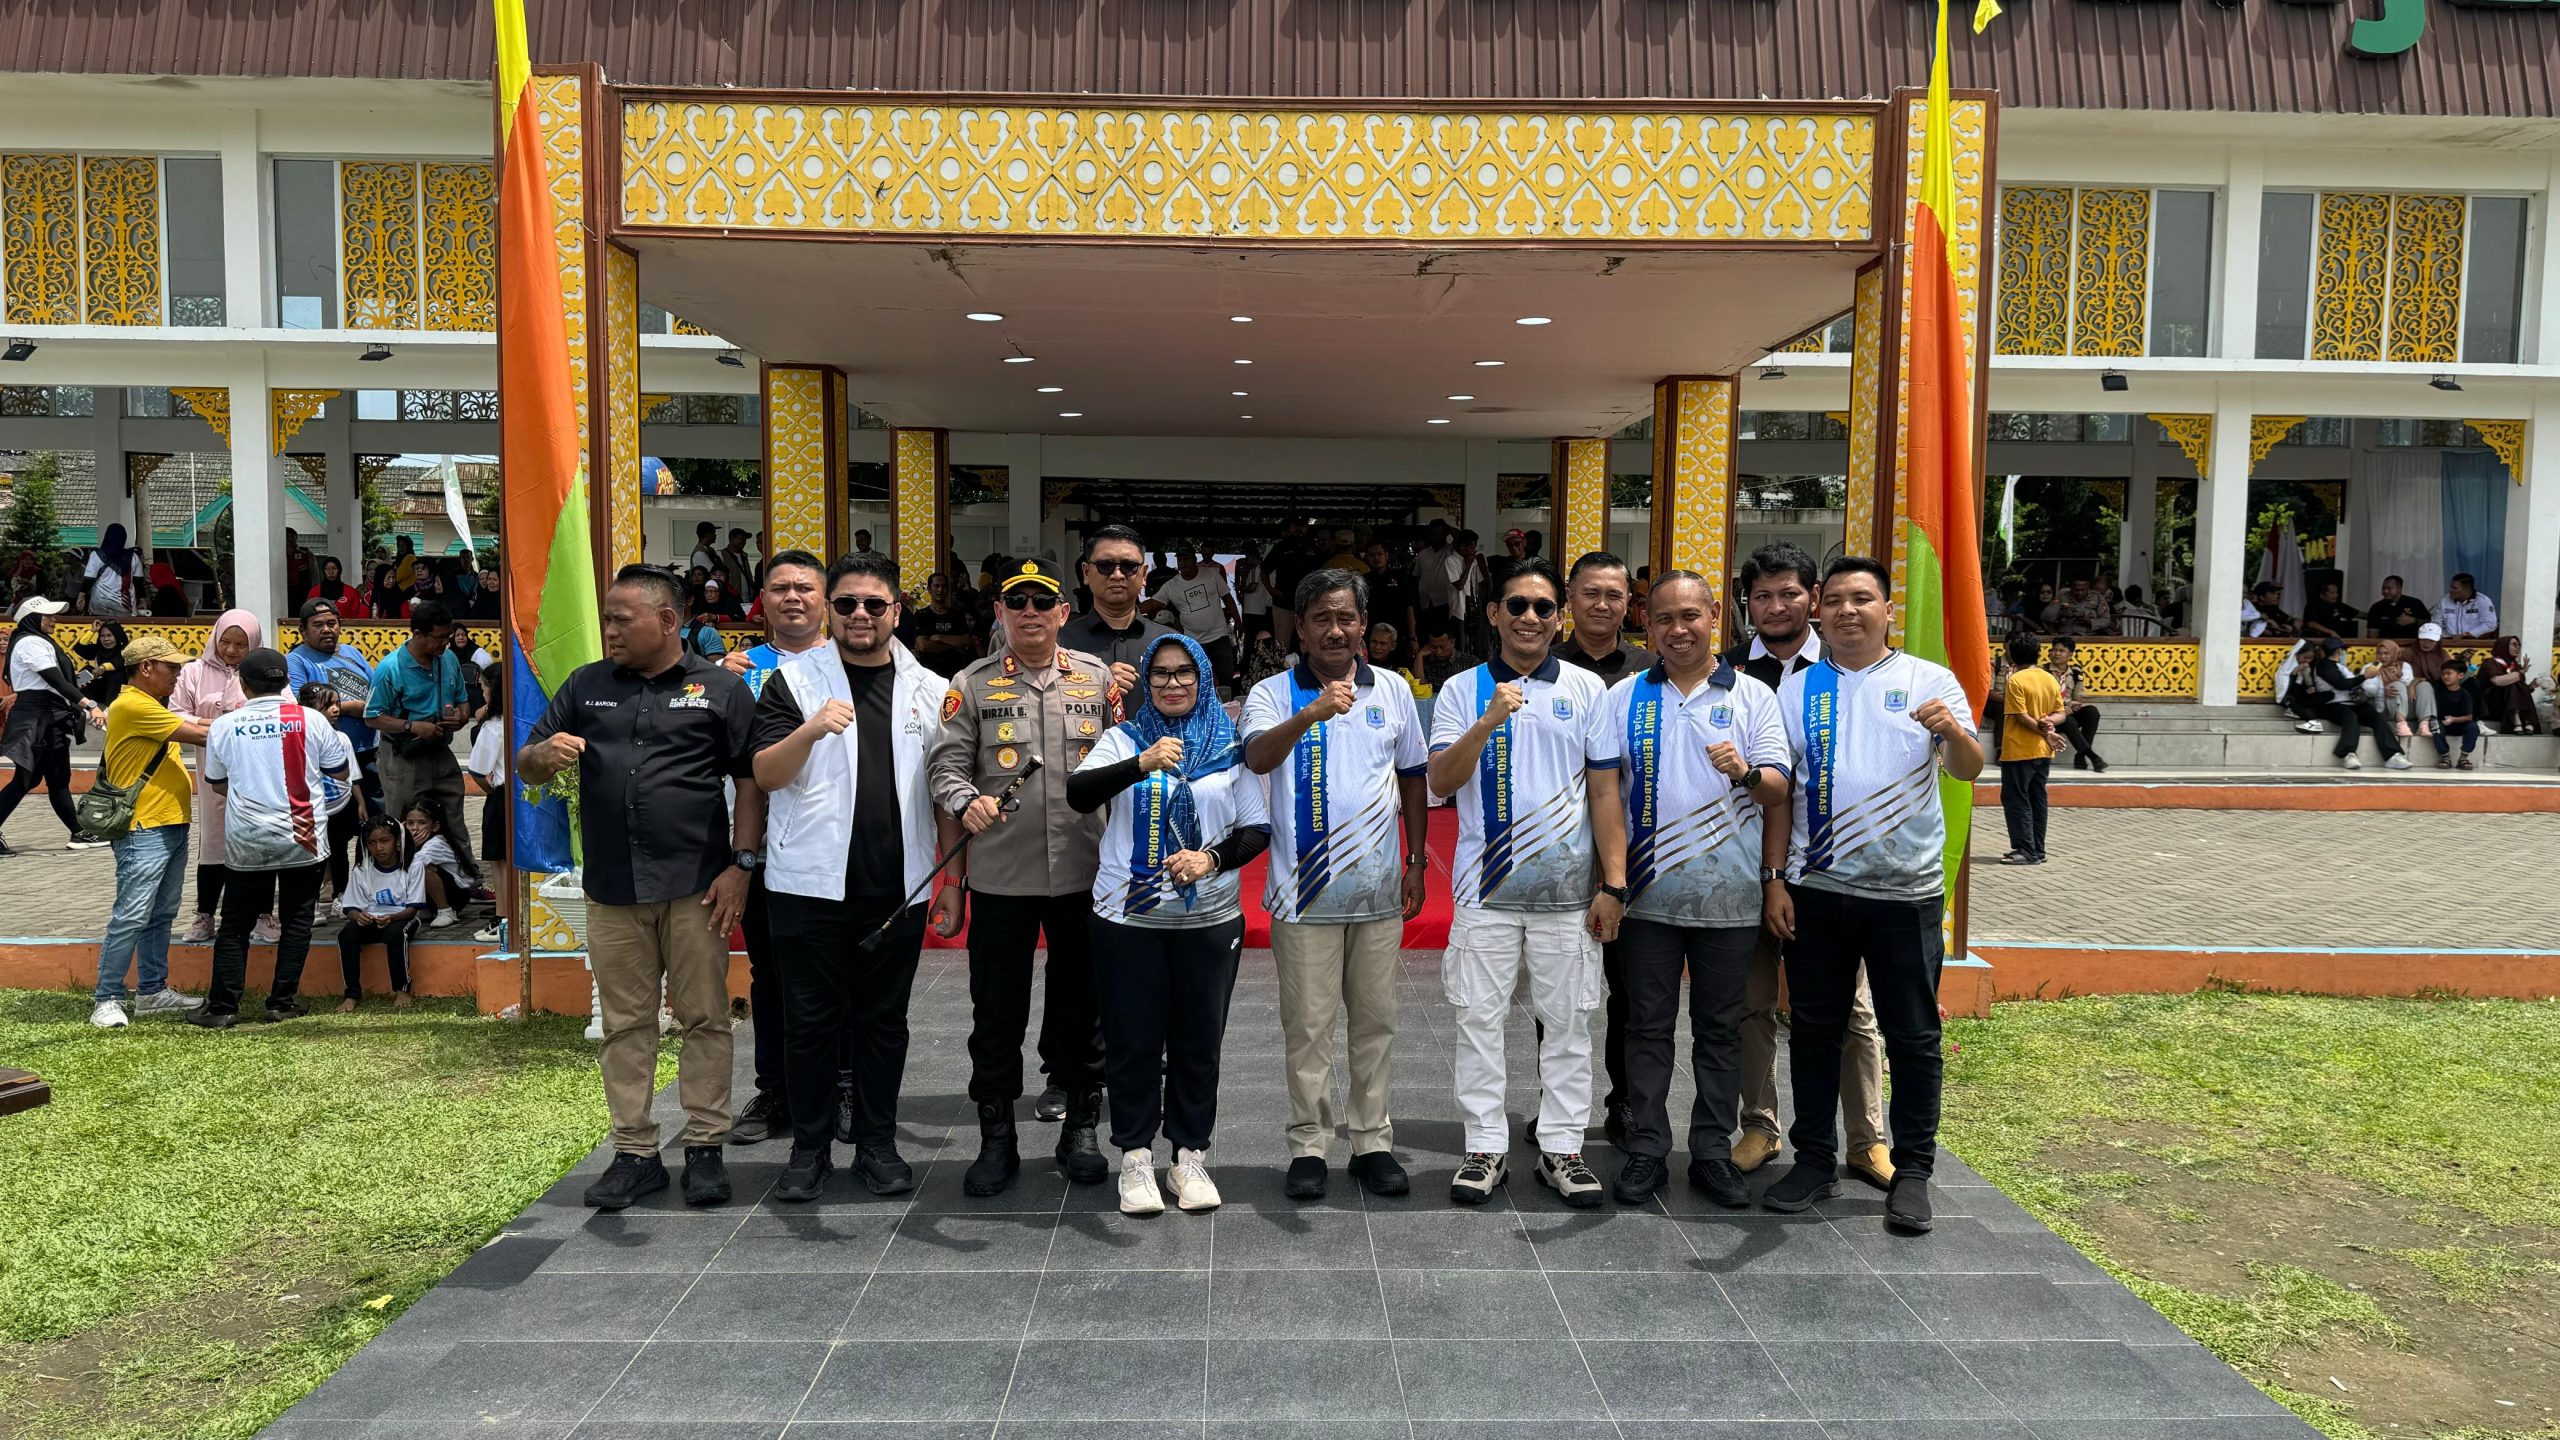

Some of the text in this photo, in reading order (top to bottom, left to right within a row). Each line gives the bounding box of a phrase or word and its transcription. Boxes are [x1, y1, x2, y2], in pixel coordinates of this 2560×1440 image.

[234, 721, 302, 737] KORMI
[1065, 703, 1104, 715] POLRI
[1311, 745, 1323, 832] BERKOLABORASI
[1496, 736, 1507, 822] BERKOLABORASI
[1641, 700, 1657, 827] SUMUT BERKOLABORASI
[1818, 691, 1832, 815] SUMUT BERKOLABORASI
[1147, 781, 1163, 868] BERKOLABORASI
